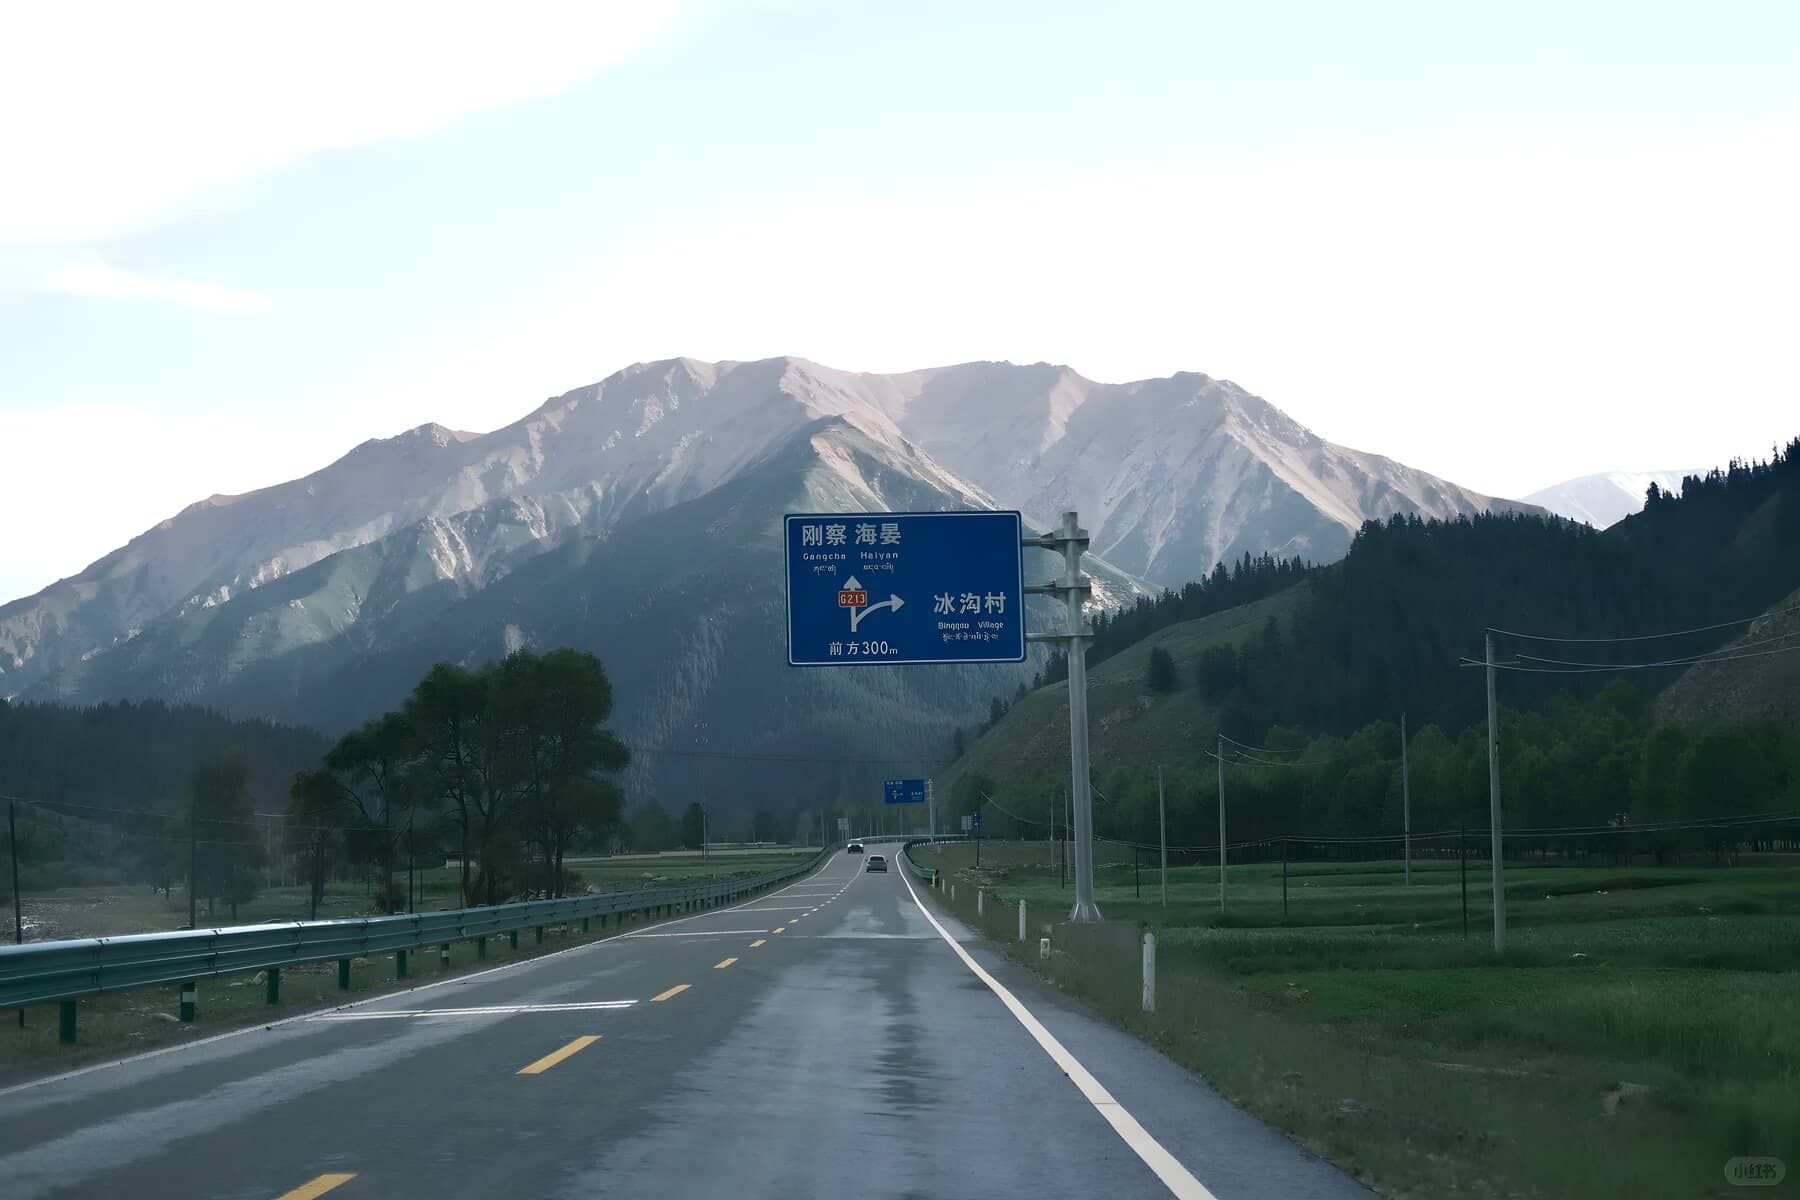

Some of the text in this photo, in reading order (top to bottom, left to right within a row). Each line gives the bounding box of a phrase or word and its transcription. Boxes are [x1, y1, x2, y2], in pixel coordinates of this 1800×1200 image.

[802, 523, 901, 546] 刚察 海晏
[803, 552, 898, 561] Gangcha Haiyan
[840, 594, 865, 604] G213
[933, 591, 1007, 615] 冰沟村
[938, 621, 1004, 631] Binggou Village
